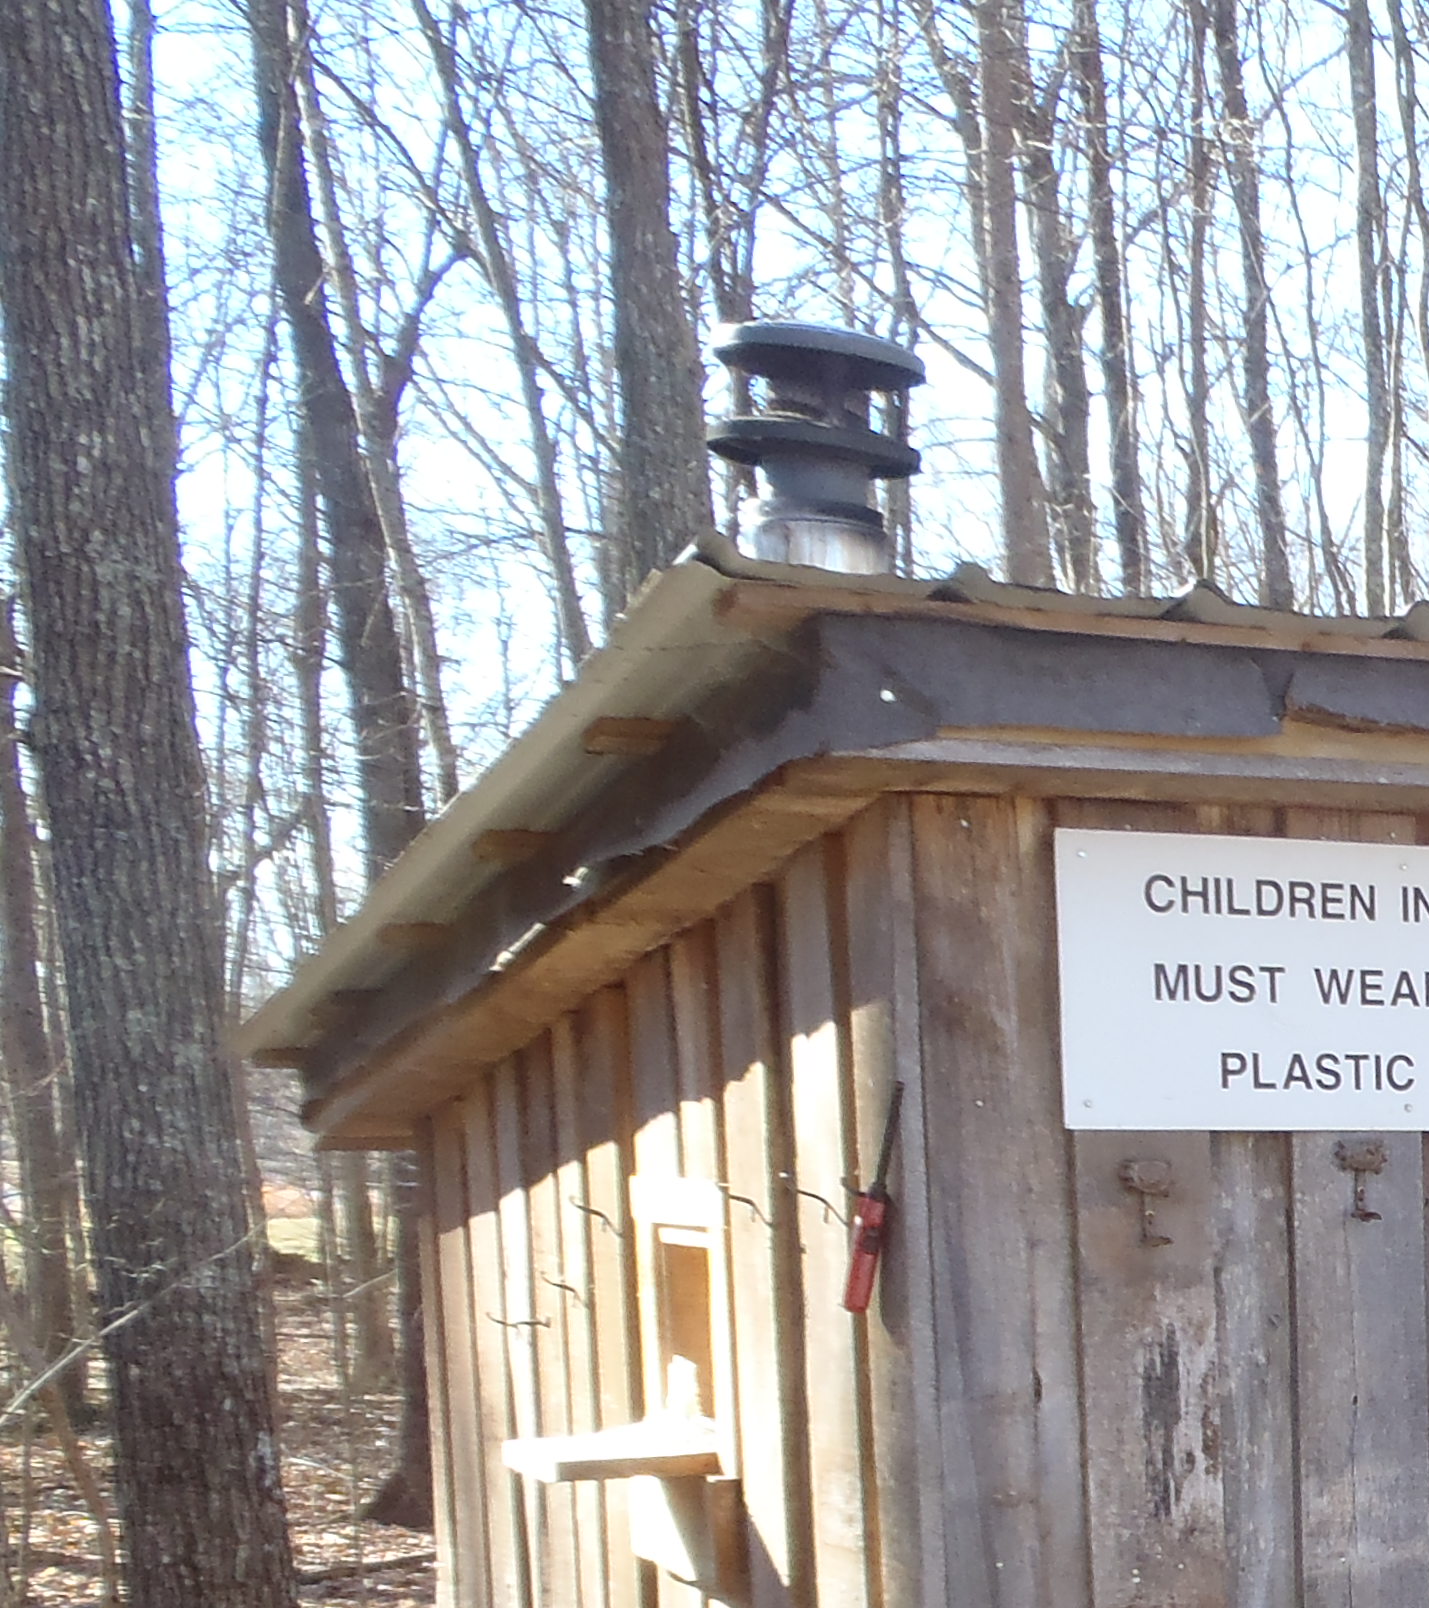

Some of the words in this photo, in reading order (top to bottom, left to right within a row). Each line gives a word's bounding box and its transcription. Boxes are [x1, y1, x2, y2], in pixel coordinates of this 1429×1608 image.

[1143, 873, 1377, 923] CHILDREN
[1153, 963, 1285, 1005] MUST
[1220, 1051, 1416, 1092] PLASTIC
